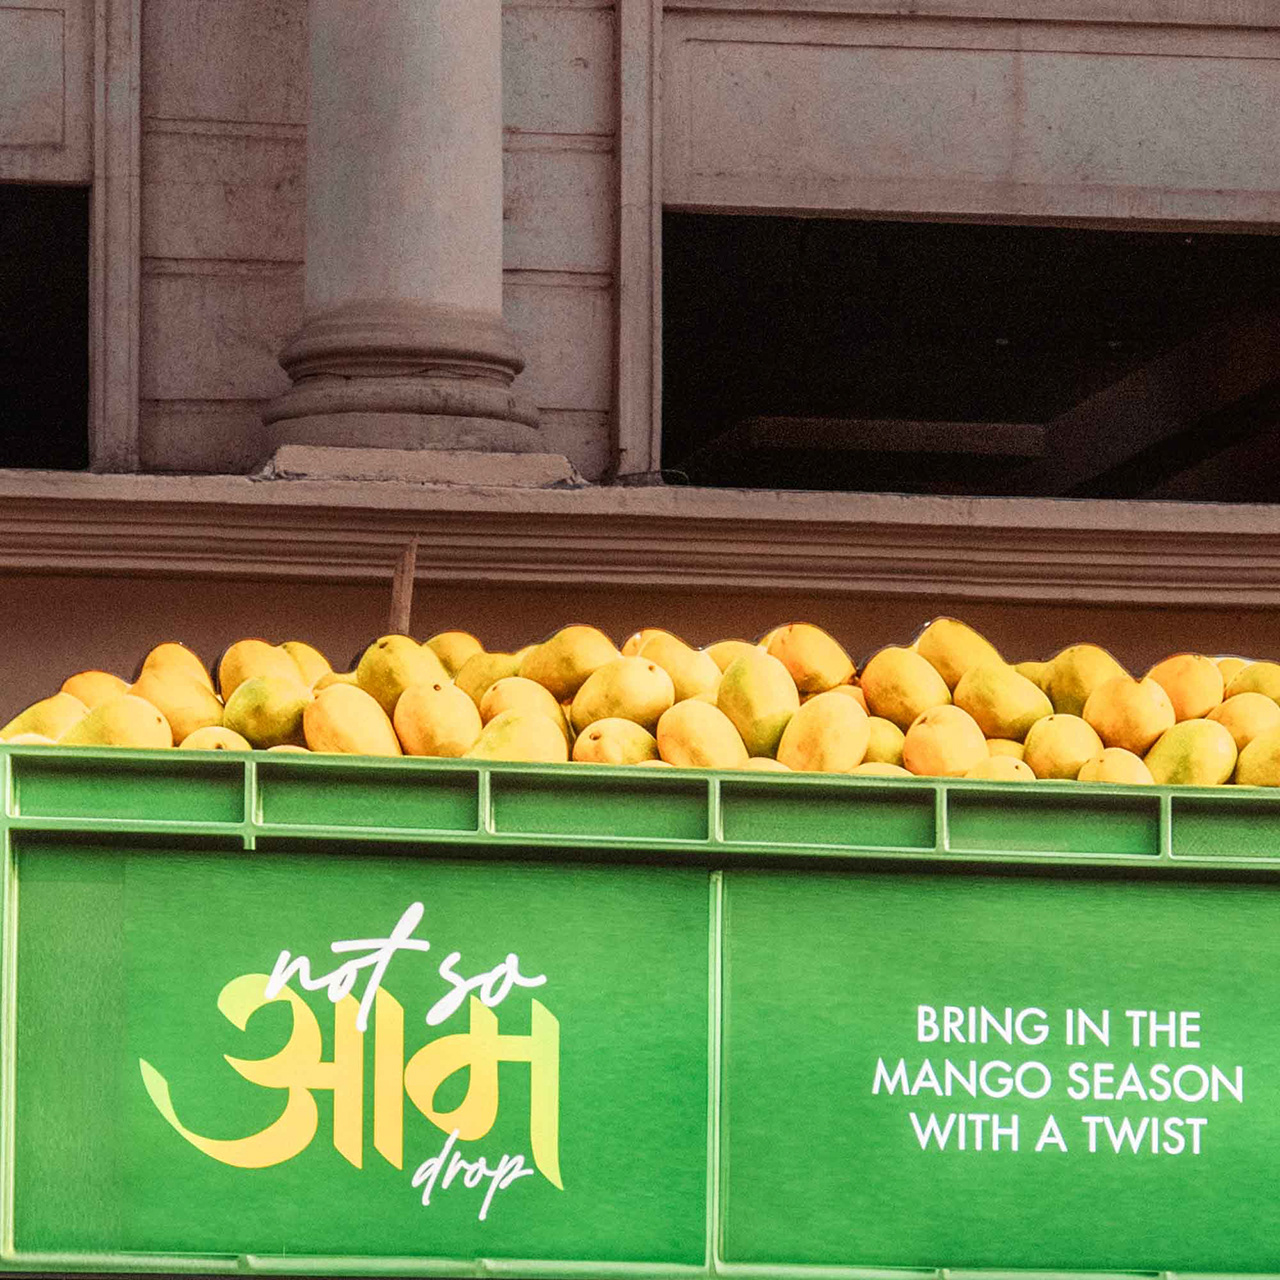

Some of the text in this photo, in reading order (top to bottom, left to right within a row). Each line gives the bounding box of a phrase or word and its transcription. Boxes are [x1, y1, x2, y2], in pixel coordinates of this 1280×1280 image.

[265, 901, 546, 1031] not so
[917, 1005, 1200, 1048] BRING IN THE
[139, 973, 564, 1191] आम
[871, 1057, 1243, 1102] MANGO SEASON
[909, 1112, 1207, 1154] WITH A TWIST
[412, 1128, 534, 1220] drop
